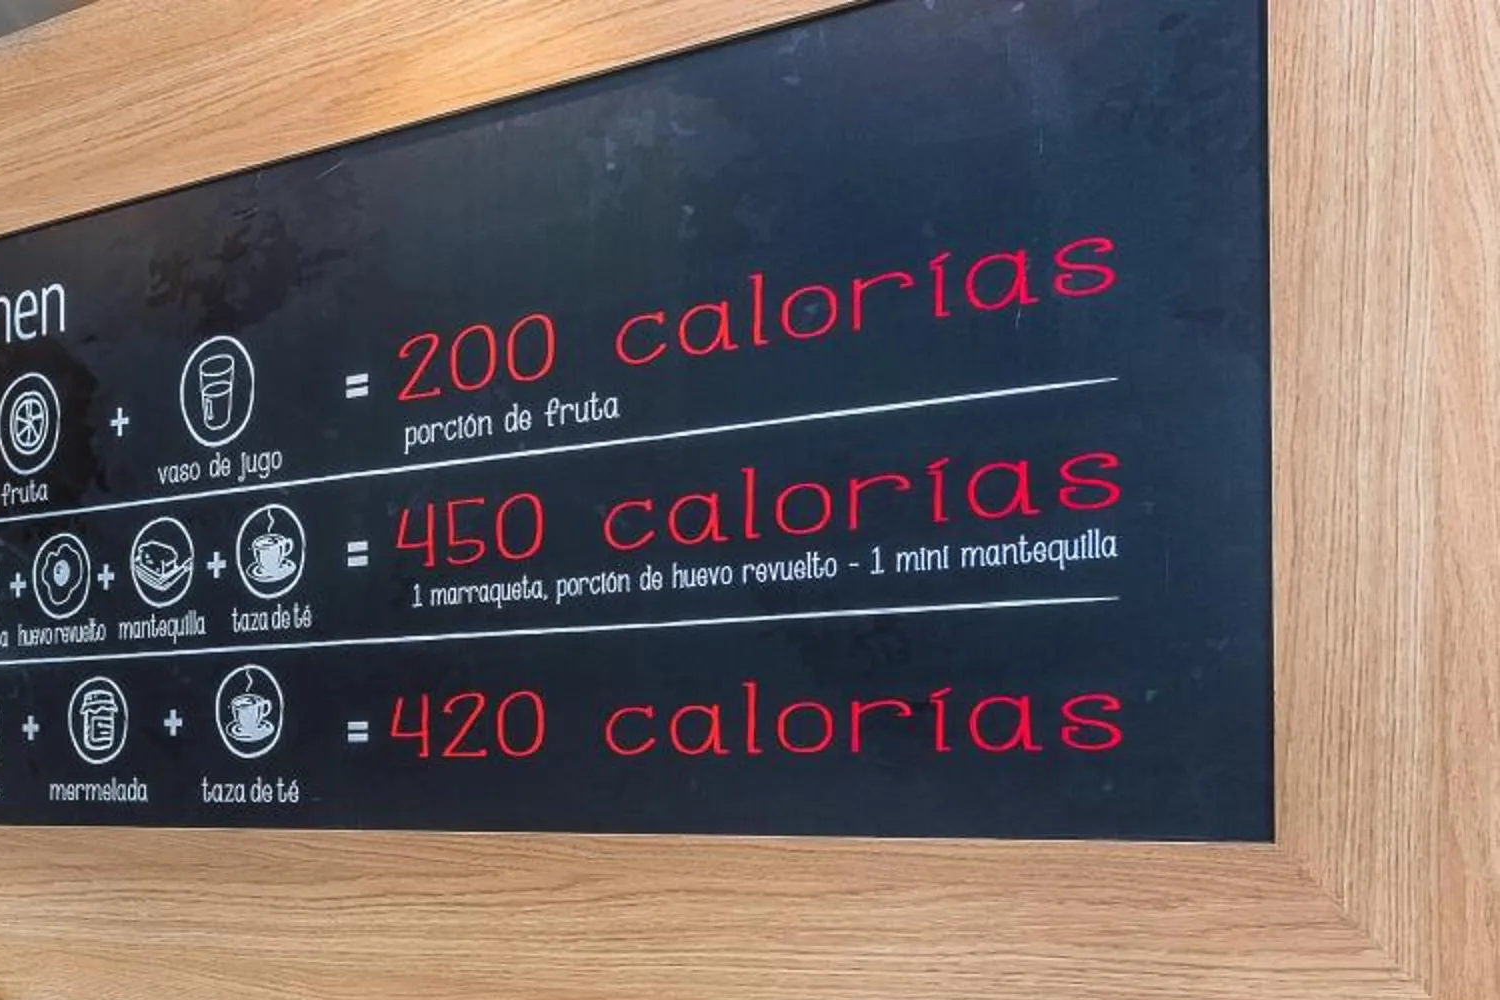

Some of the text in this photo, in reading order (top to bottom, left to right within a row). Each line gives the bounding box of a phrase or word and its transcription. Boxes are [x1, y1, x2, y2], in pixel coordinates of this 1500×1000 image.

[396, 312, 557, 402] 200
[614, 236, 1117, 366] calorías
[403, 391, 622, 455] porción de fruta
[157, 449, 284, 485] vaso de jugo
[0, 479, 49, 506] fruta
[394, 492, 546, 568] 450
[602, 450, 1122, 551] calorías
[411, 583, 424, 608] 1
[430, 574, 549, 609] marraqueta,
[555, 571, 631, 605] porción
[639, 564, 663, 591] de
[672, 562, 734, 589] huevo
[741, 551, 838, 584] revuelto
[870, 547, 885, 575] 1
[896, 544, 950, 573] mini
[960, 528, 1120, 571] mantequilla
[16, 620, 107, 647] huevo revuelto
[118, 609, 207, 645] mantequilla
[231, 602, 313, 632] taza de té
[389, 690, 547, 760] 420
[603, 678, 1125, 757] calorías
[48, 777, 148, 803] mermelada
[200, 776, 300, 804] taza de té
